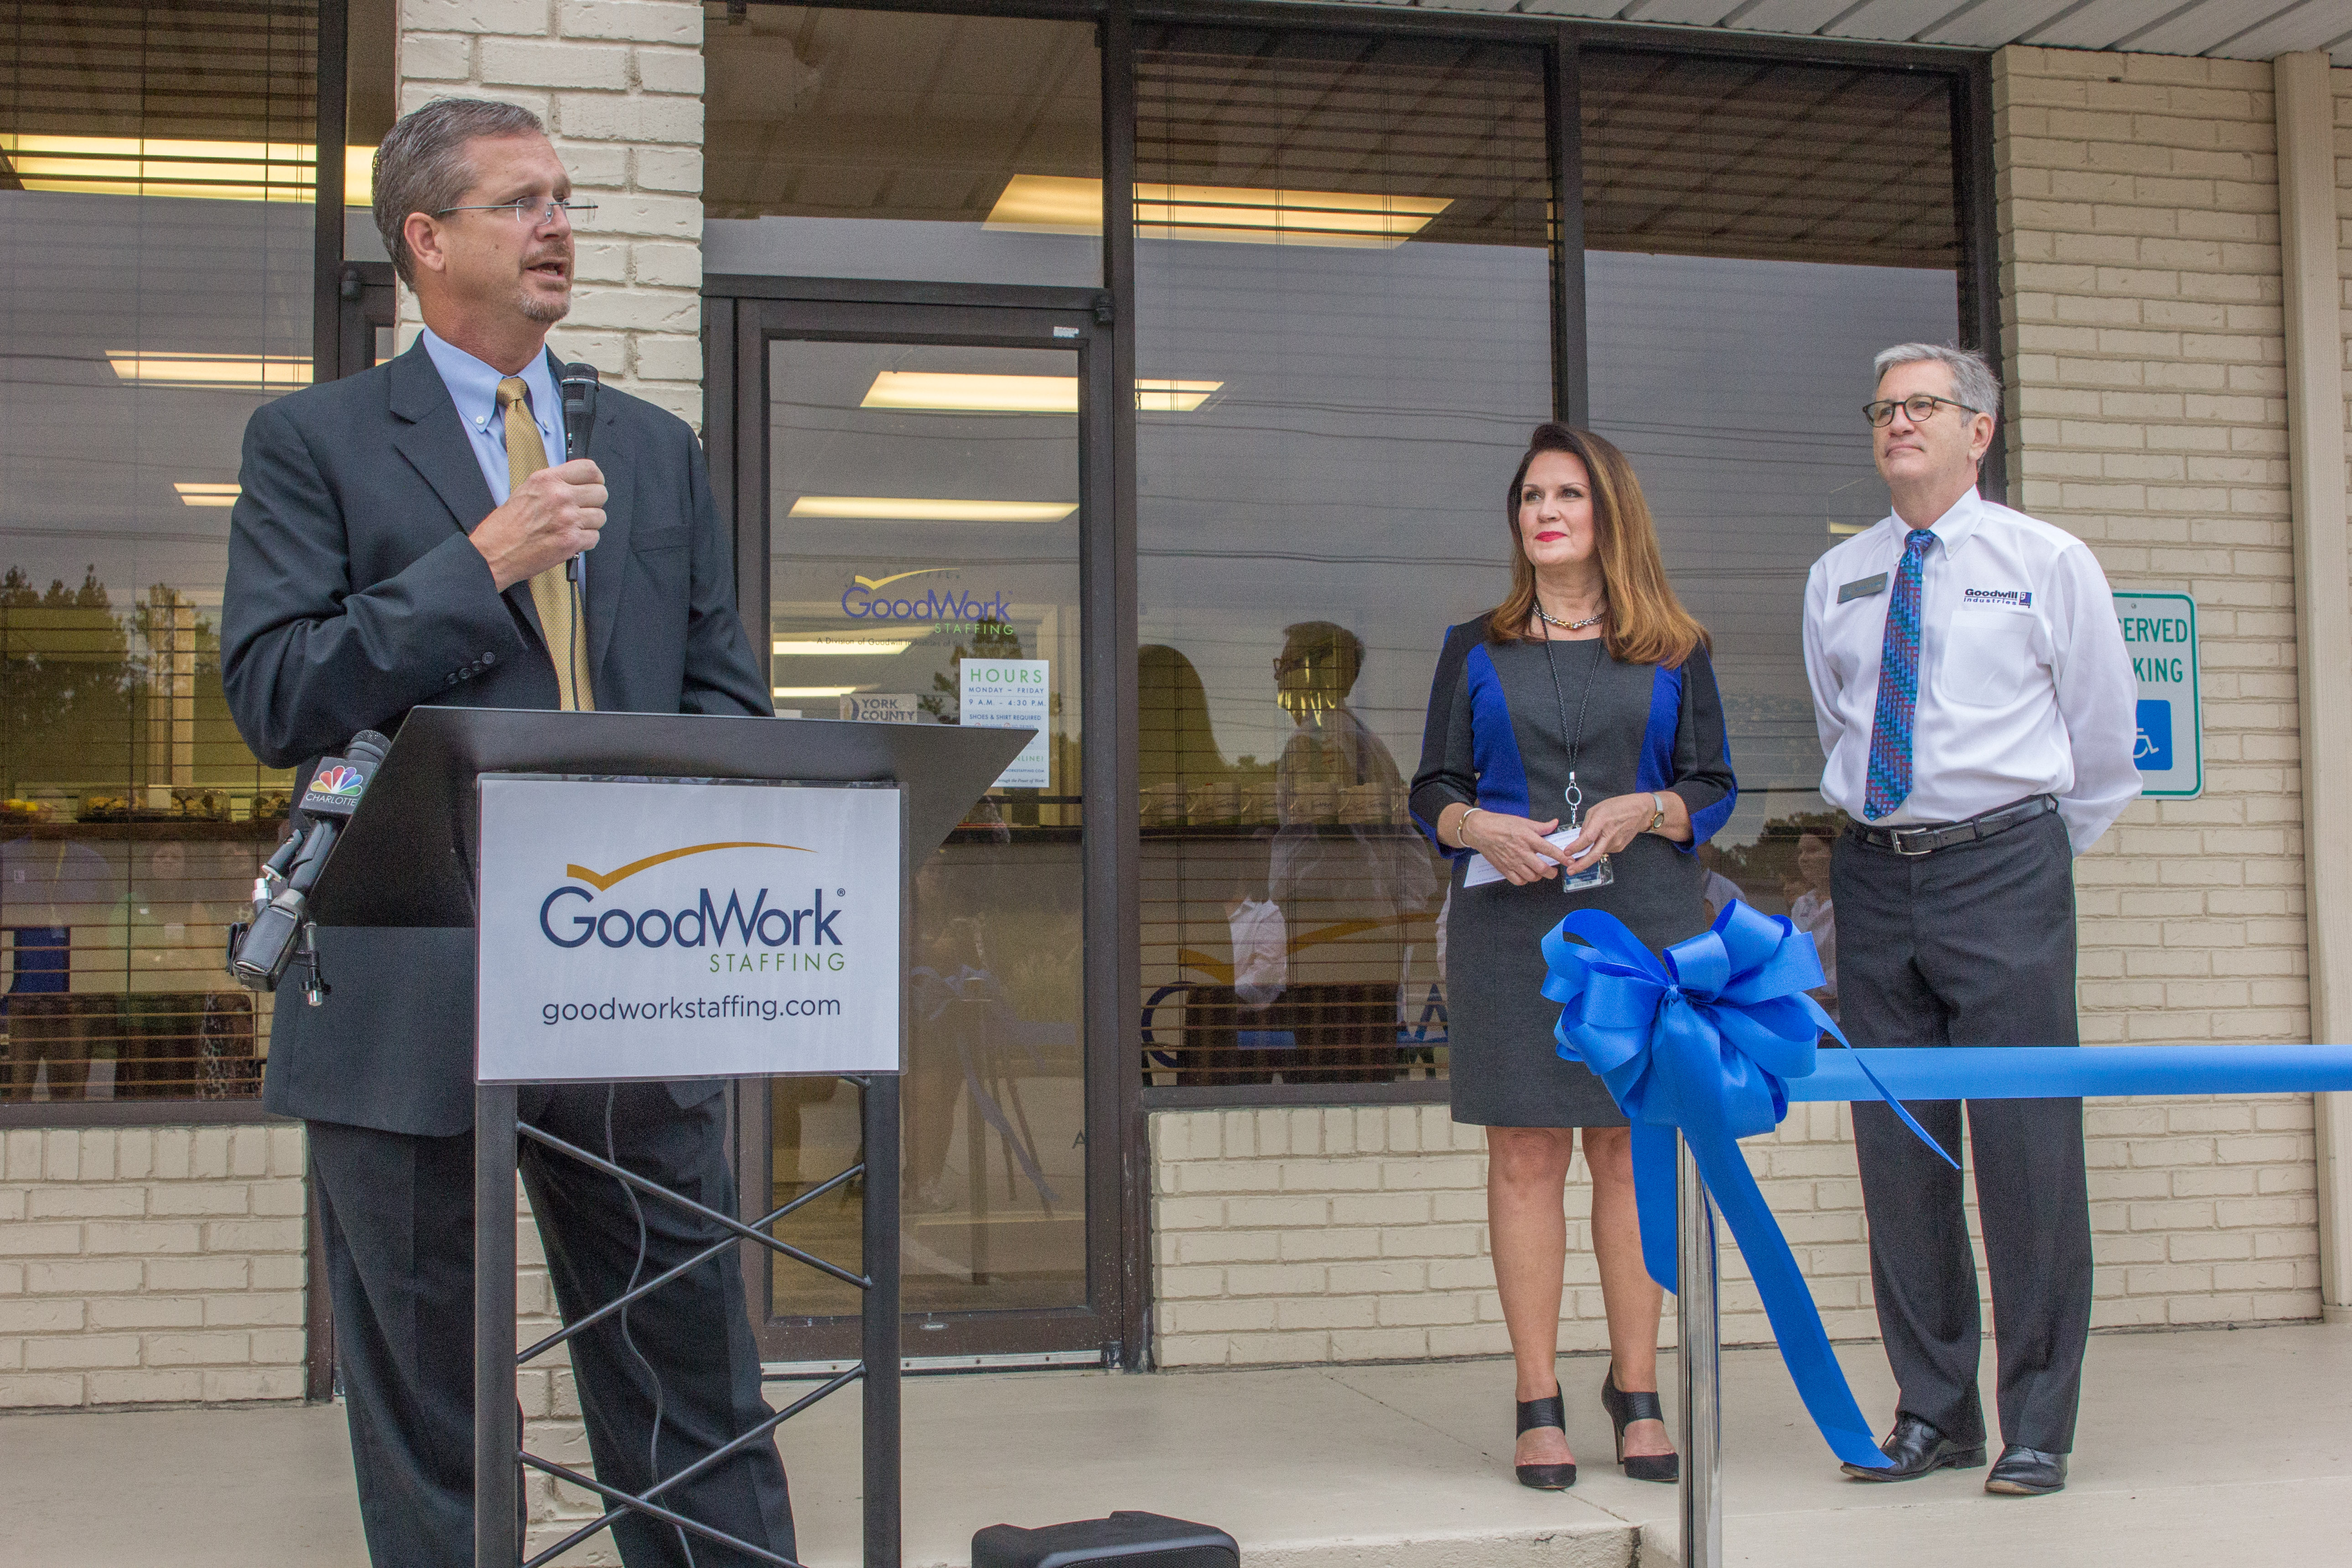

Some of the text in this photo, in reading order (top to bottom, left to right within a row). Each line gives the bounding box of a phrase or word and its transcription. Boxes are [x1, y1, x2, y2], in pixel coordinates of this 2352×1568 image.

[1965, 589, 2018, 599] Goodwill
[841, 587, 1011, 622] GoodWork
[935, 623, 1013, 635] STAFFING
[2118, 618, 2187, 643] ERVED
[971, 668, 1042, 683] HOURS
[2133, 658, 2183, 683] KING
[862, 699, 898, 709] YORK
[861, 710, 914, 721] COUNTY
[306, 793, 357, 806] CHARLOTTE
[710, 952, 845, 972] STAFFING
[542, 996, 841, 1025] goodworkstaffing.com
